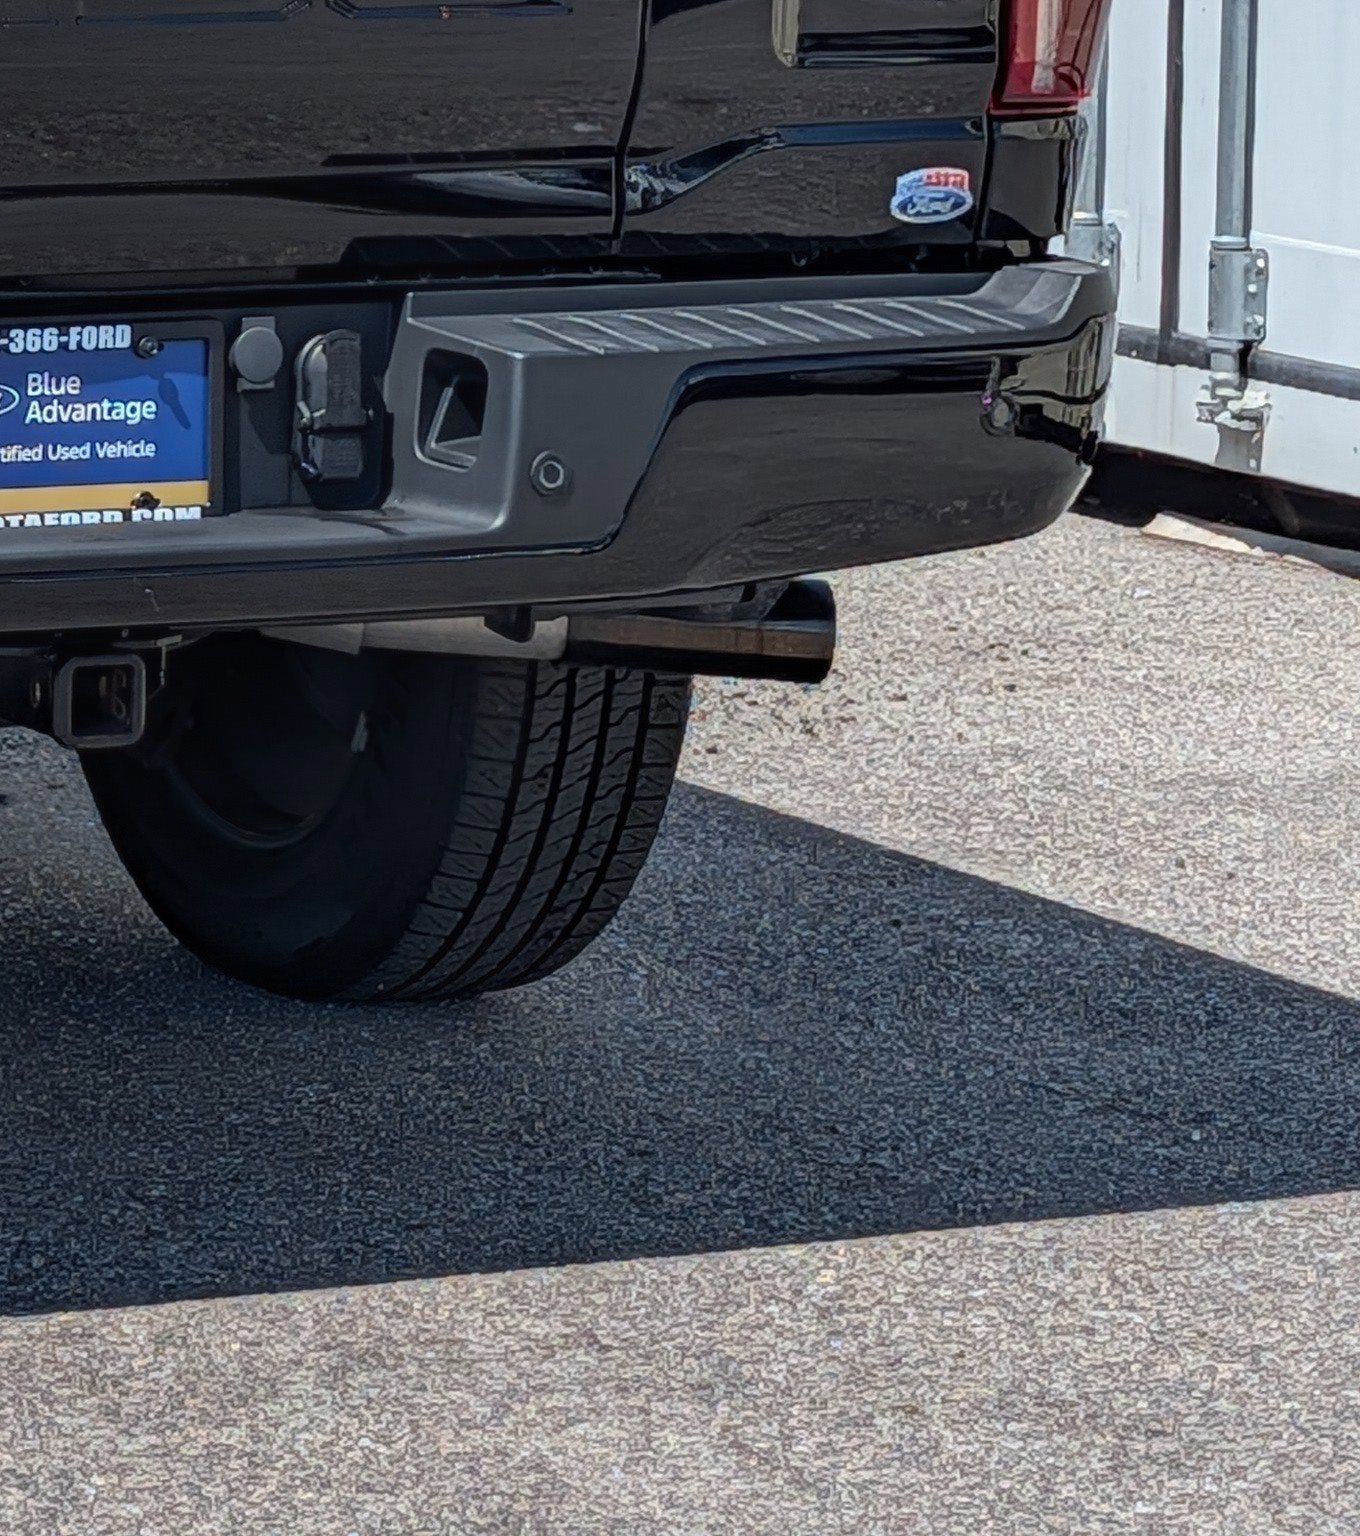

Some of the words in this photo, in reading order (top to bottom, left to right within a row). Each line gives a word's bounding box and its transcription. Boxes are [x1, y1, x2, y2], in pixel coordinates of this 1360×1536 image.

[25, 371, 82, 396] Blue
[23, 397, 159, 426] Advantage
[47, 442, 91, 461] Used
[94, 438, 157, 459] Vehicle
